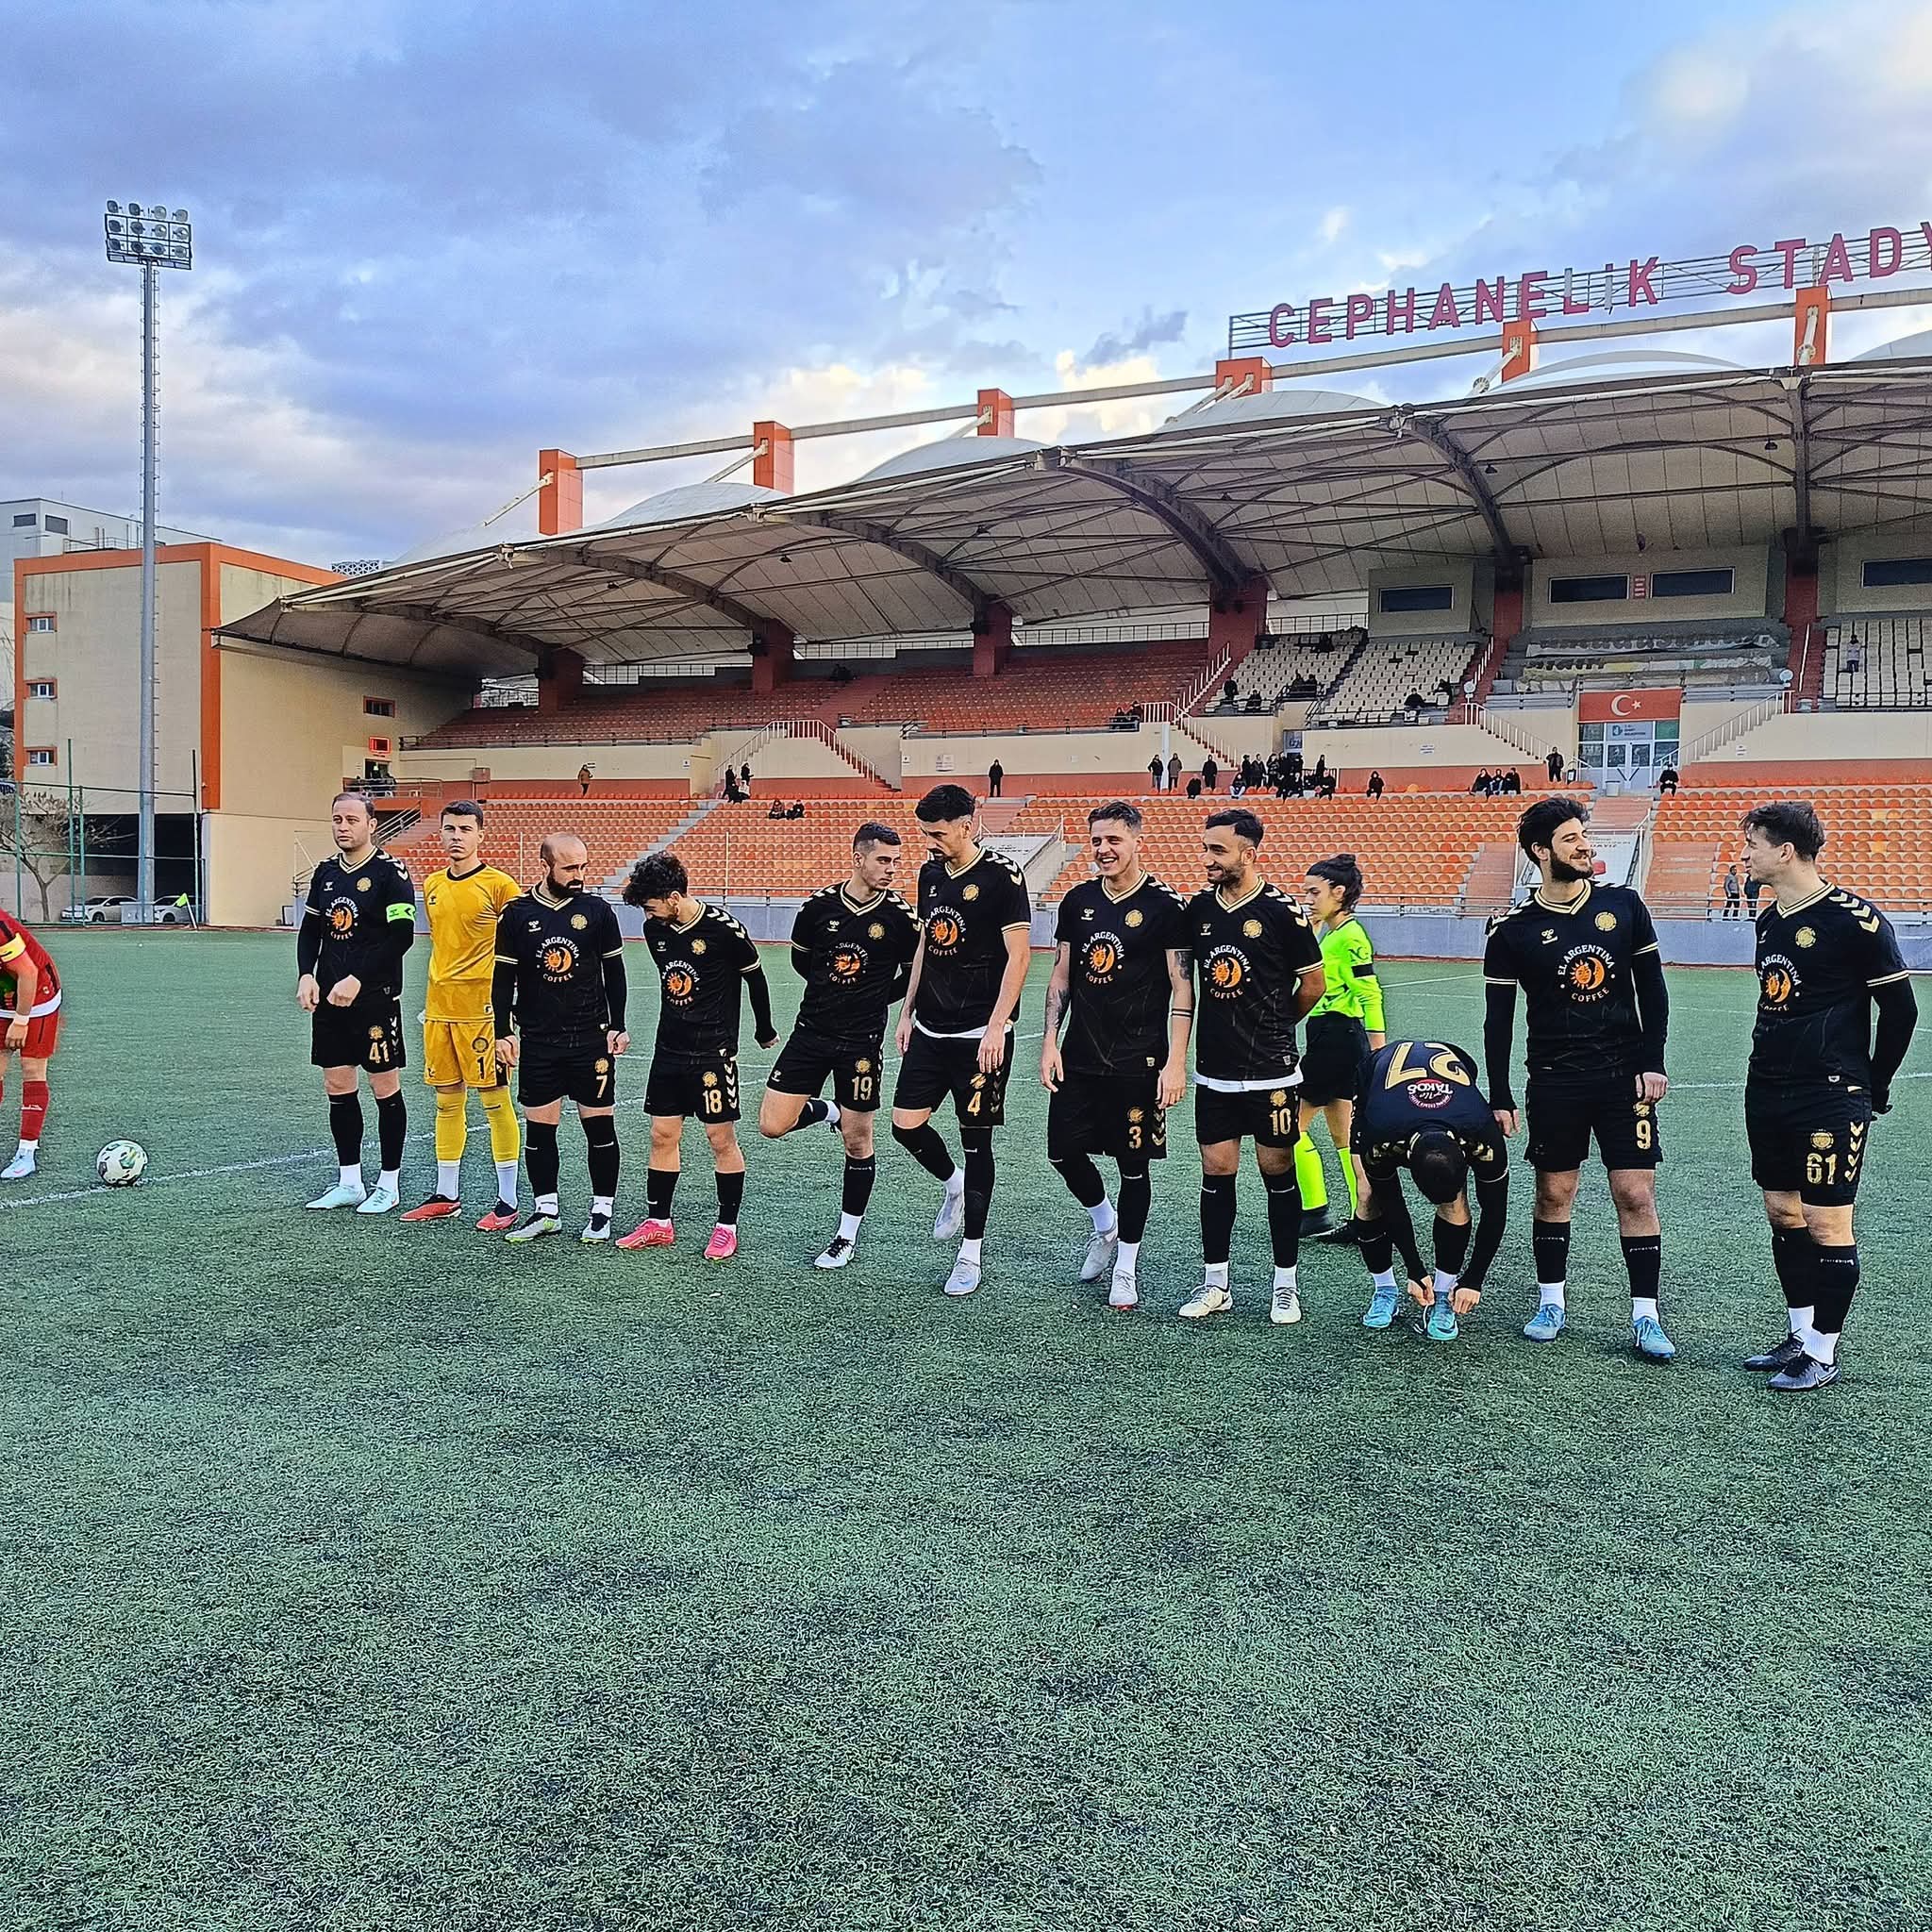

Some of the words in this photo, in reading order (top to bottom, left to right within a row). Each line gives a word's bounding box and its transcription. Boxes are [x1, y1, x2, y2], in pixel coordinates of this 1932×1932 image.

[930, 906, 967, 933] ARGENTINA
[541, 937, 580, 959] ARGENTINA
[1090, 931, 1125, 960] ARGENTINA
[1563, 944, 1615, 969] ARGENTINA
[1209, 944, 1252, 973] ARGENTINA
[1761, 954, 1803, 987] ARGENTINA
[1209, 988, 1243, 1000] COFFEE
[1571, 987, 1610, 1003] COFFEE
[369, 1041, 390, 1064] 41
[476, 1057, 486, 1079] 1
[1385, 1041, 1471, 1090] 27
[595, 1074, 608, 1099] 7
[852, 1076, 873, 1101] 19
[1407, 1083, 1454, 1095] TAKOS
[702, 1089, 723, 1114] 18
[967, 1091, 981, 1116] 4
[1269, 1108, 1291, 1136] 10
[1128, 1125, 1141, 1149] 3
[1636, 1120, 1651, 1150] 9
[1807, 1153, 1838, 1185] 61
